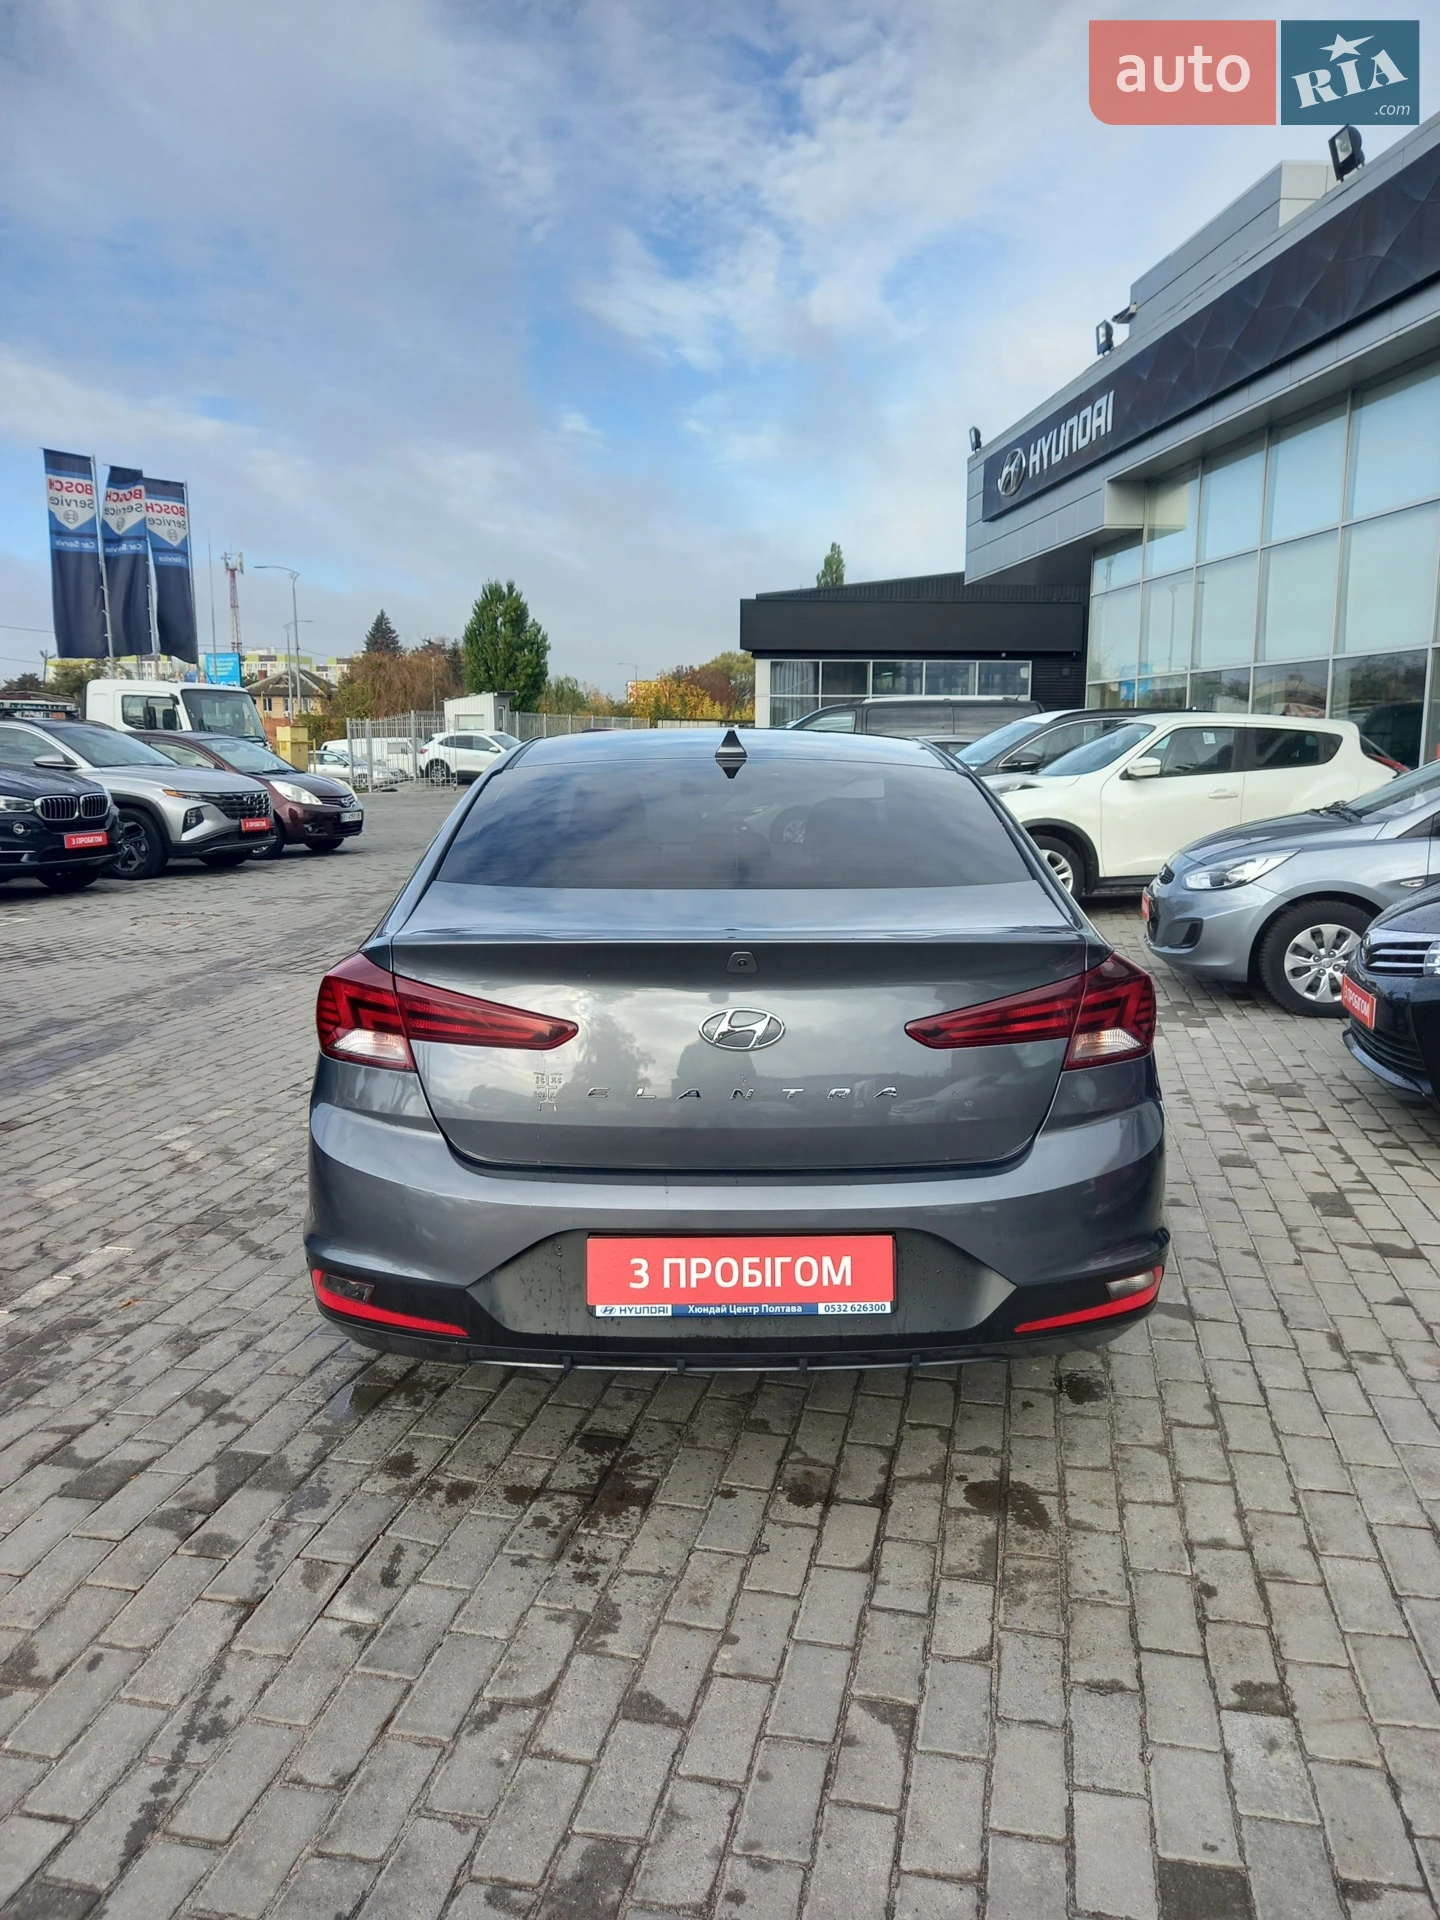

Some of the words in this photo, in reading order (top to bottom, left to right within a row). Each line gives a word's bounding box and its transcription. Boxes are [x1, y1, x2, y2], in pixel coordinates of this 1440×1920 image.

[1029, 389, 1115, 479] HYUNDAI
[586, 1086, 899, 1100] ELANTRA
[662, 1255, 852, 1289] ПРОБІГОМ
[619, 1306, 669, 1315] HYUNDAI
[687, 1304, 727, 1315] Хюндай
[729, 1304, 760, 1315] Центр
[761, 1303, 803, 1314] Полтава
[824, 1303, 848, 1313] 0532
[850, 1303, 886, 1313] 626300
